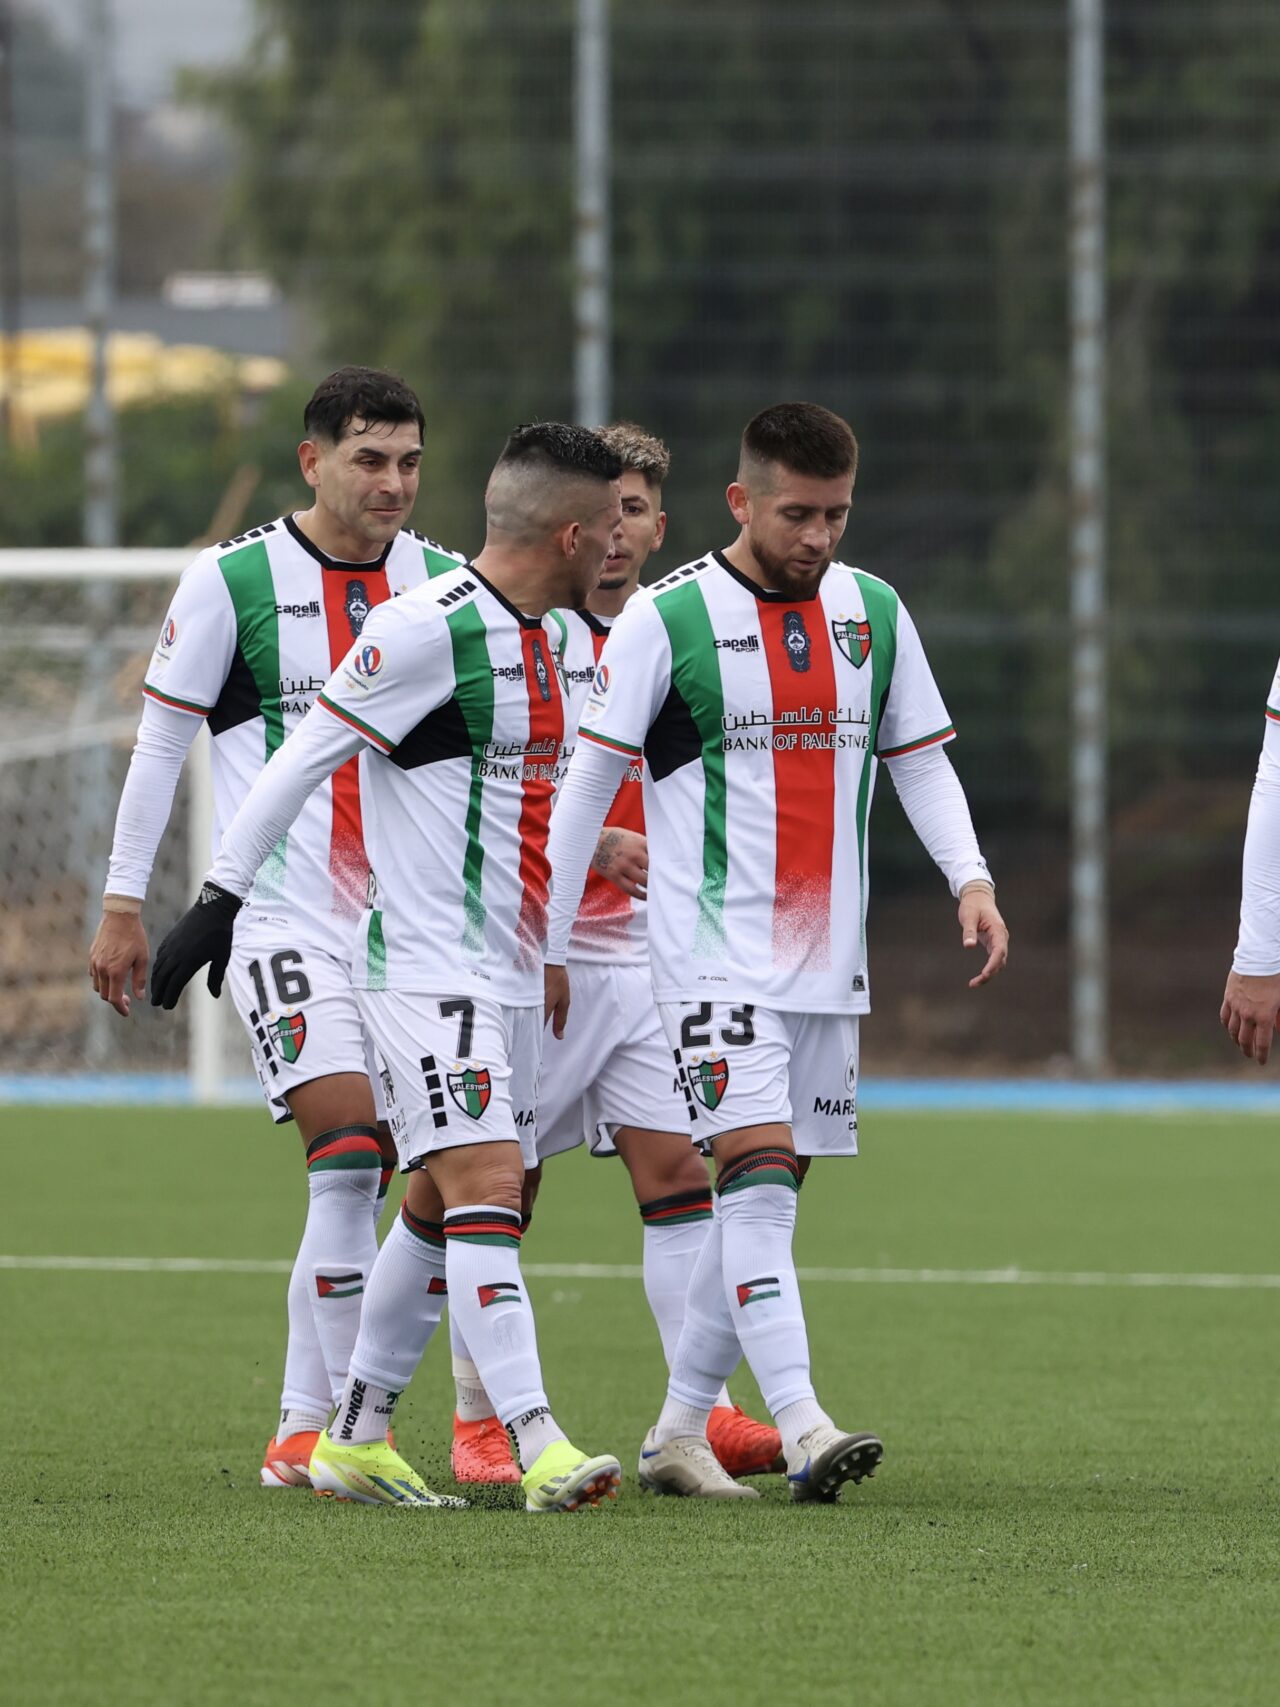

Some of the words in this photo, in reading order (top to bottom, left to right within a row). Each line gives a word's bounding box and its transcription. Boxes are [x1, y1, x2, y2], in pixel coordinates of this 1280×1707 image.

[274, 601, 320, 616] capelli
[713, 635, 759, 652] capelli
[837, 631, 869, 641] PALESTINO
[565, 666, 595, 682] apelli
[722, 706, 823, 732] فلسطين
[723, 735, 769, 752] BANK
[774, 733, 798, 750] OF
[802, 733, 870, 750] PALESTNE
[478, 762, 520, 780] BANK
[523, 763, 538, 781] OF
[248, 948, 313, 1017] 16
[437, 998, 476, 1060] 7
[680, 1001, 756, 1050] 23
[452, 1082, 489, 1092] PALESTINO
[339, 1377, 367, 1441] WONDE
